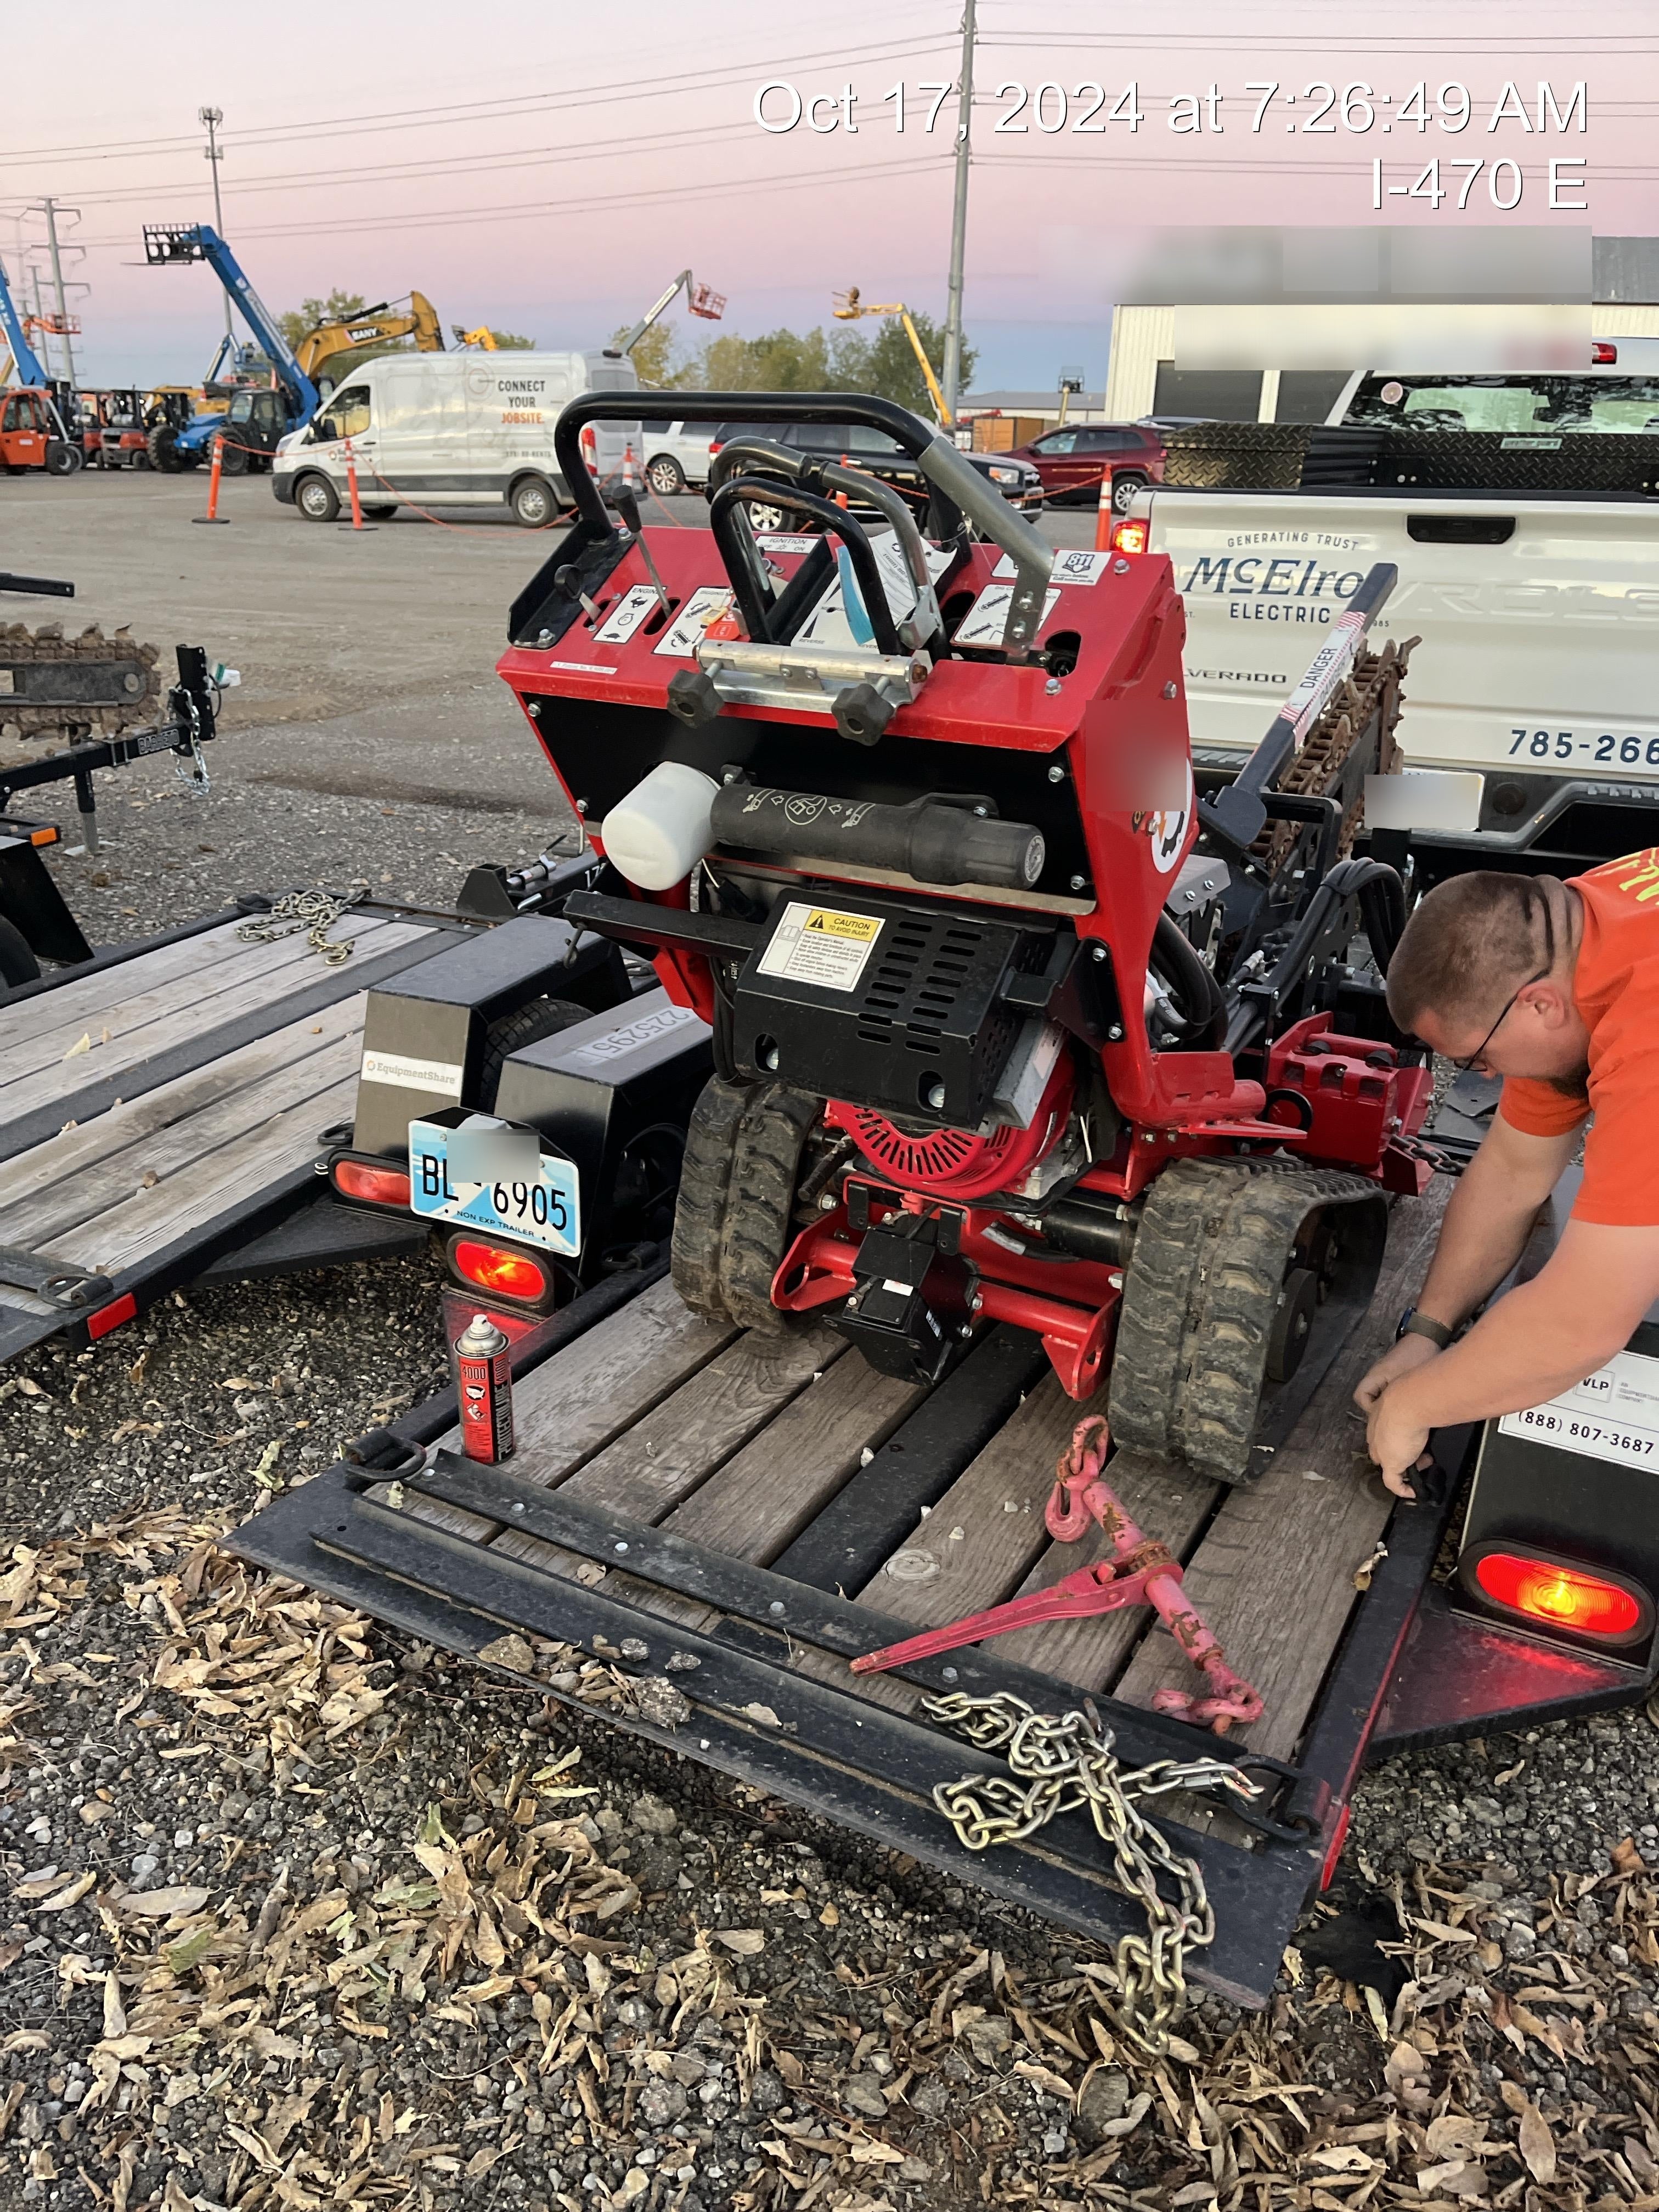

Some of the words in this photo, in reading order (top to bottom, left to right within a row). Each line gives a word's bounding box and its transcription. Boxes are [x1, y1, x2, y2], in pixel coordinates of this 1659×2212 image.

[498, 380, 545, 392] CONNECT
[509, 396, 537, 407] YOUR
[1228, 532, 1309, 547] GENERATING
[1317, 534, 1359, 550] TRUST
[1069, 553, 1095, 566] 811
[1182, 557, 1365, 598] McElro
[1231, 603, 1330, 623] ELECTRIC
[1300, 648, 1338, 688] DANGER
[834, 918, 870, 930] CAUTION
[592, 1010, 690, 1054] 225295
[377, 1063, 455, 1084] EquipmentShare
[457, 1210, 477, 1220] NON
[479, 1216, 495, 1224] EXP
[498, 1221, 534, 1237] TRAILER
[462, 1366, 486, 1380] 4000
[1519, 1410, 1562, 1432] (888)
[1570, 1423, 1655, 1455] 807-3687
